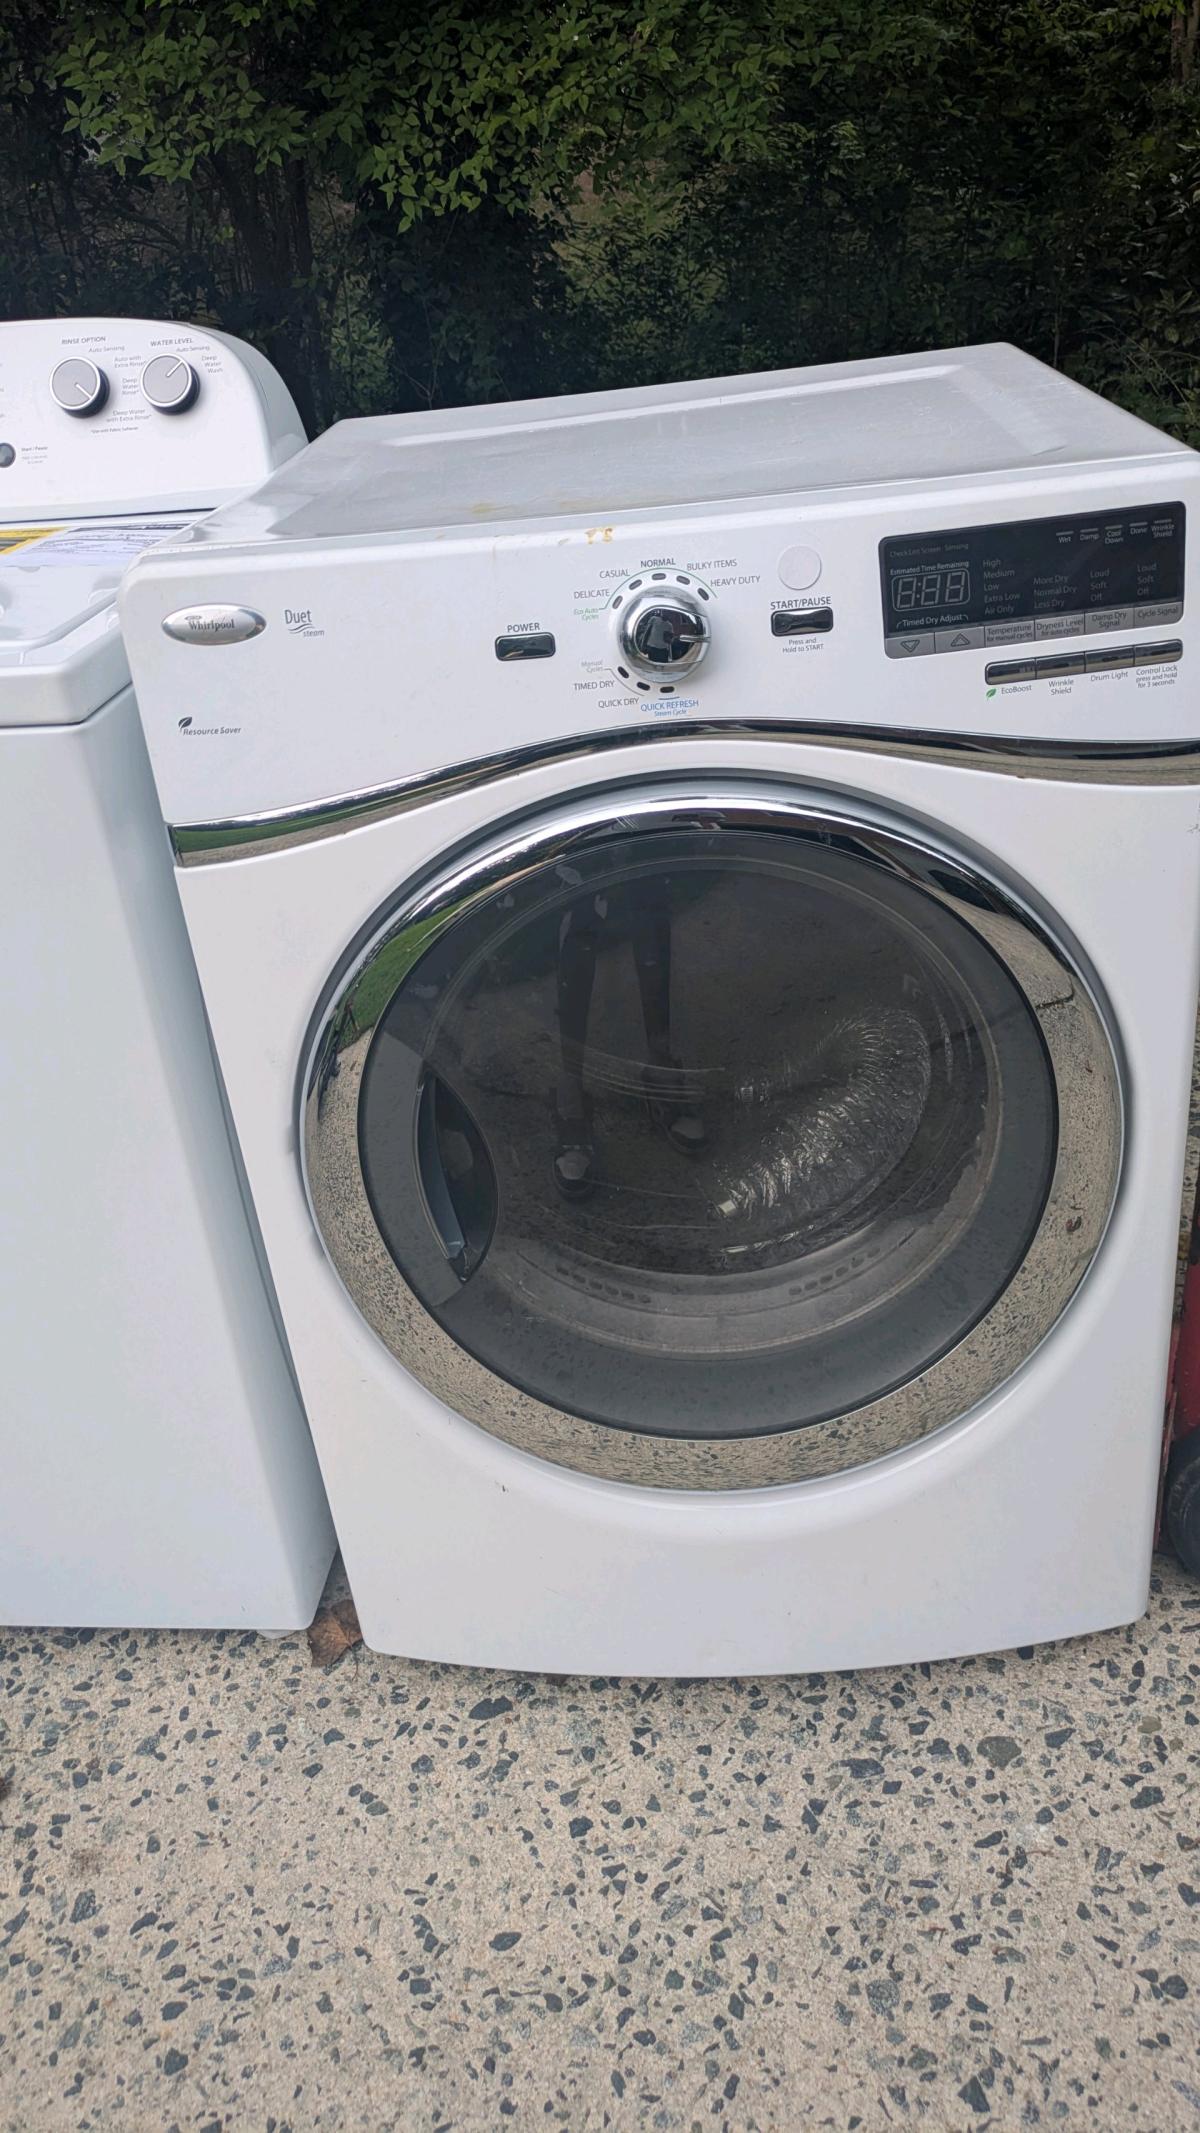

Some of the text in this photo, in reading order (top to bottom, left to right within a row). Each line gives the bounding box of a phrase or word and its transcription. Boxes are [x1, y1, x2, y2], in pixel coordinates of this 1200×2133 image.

[1130, 527, 1147, 535] Done
[1105, 536, 1123, 544] Down
[640, 558, 676, 568] NORMAL
[687, 559, 737, 571] BULKY ITEMS
[983, 559, 1001, 567] High
[1137, 563, 1157, 572] Loud
[890, 567, 920, 575] Estimated
[937, 561, 969, 570] Remaining
[600, 570, 630, 578] CASUAL
[984, 570, 1015, 579] Medium
[1090, 569, 1109, 577] Loud
[711, 576, 760, 587] HEAVY DUTY
[1034, 575, 1069, 585] More Dry
[1137, 576, 1154, 584] Soft
[1034, 585, 1077, 596] Normal Dry
[1091, 582, 1107, 590] Soft
[574, 590, 610, 599] DELICATE
[1137, 587, 1149, 596] Off
[984, 595, 1003, 603] Extra
[1091, 594, 1102, 602] Off
[770, 596, 832, 610] START/PAUSE
[1052, 599, 1064, 607] Dry
[284, 610, 312, 624] Duet
[1092, 611, 1127, 622] Damp Dry
[1138, 607, 1178, 618] Cycle Signal
[903, 614, 962, 627] Timed Dry Adjust
[1036, 618, 1084, 632] Dryness Level
[1099, 619, 1120, 629] Signal
[188, 619, 235, 632] Whirlpool
[507, 623, 540, 632] POWER
[987, 624, 1031, 636] Temperature
[303, 629, 324, 637] steam
[1063, 627, 1080, 635] cycles
[994, 633, 1015, 641] manual
[1136, 667, 1160, 675] Control
[1112, 671, 1128, 681] Light
[574, 681, 615, 690] TIMED DRY
[1048, 678, 1074, 687] Wrinkle
[1001, 685, 1032, 694] EcoBoost
[1051, 687, 1072, 696] Shield
[598, 698, 639, 708] QUICK DRY
[641, 700, 699, 712] QUICK REFRESH
